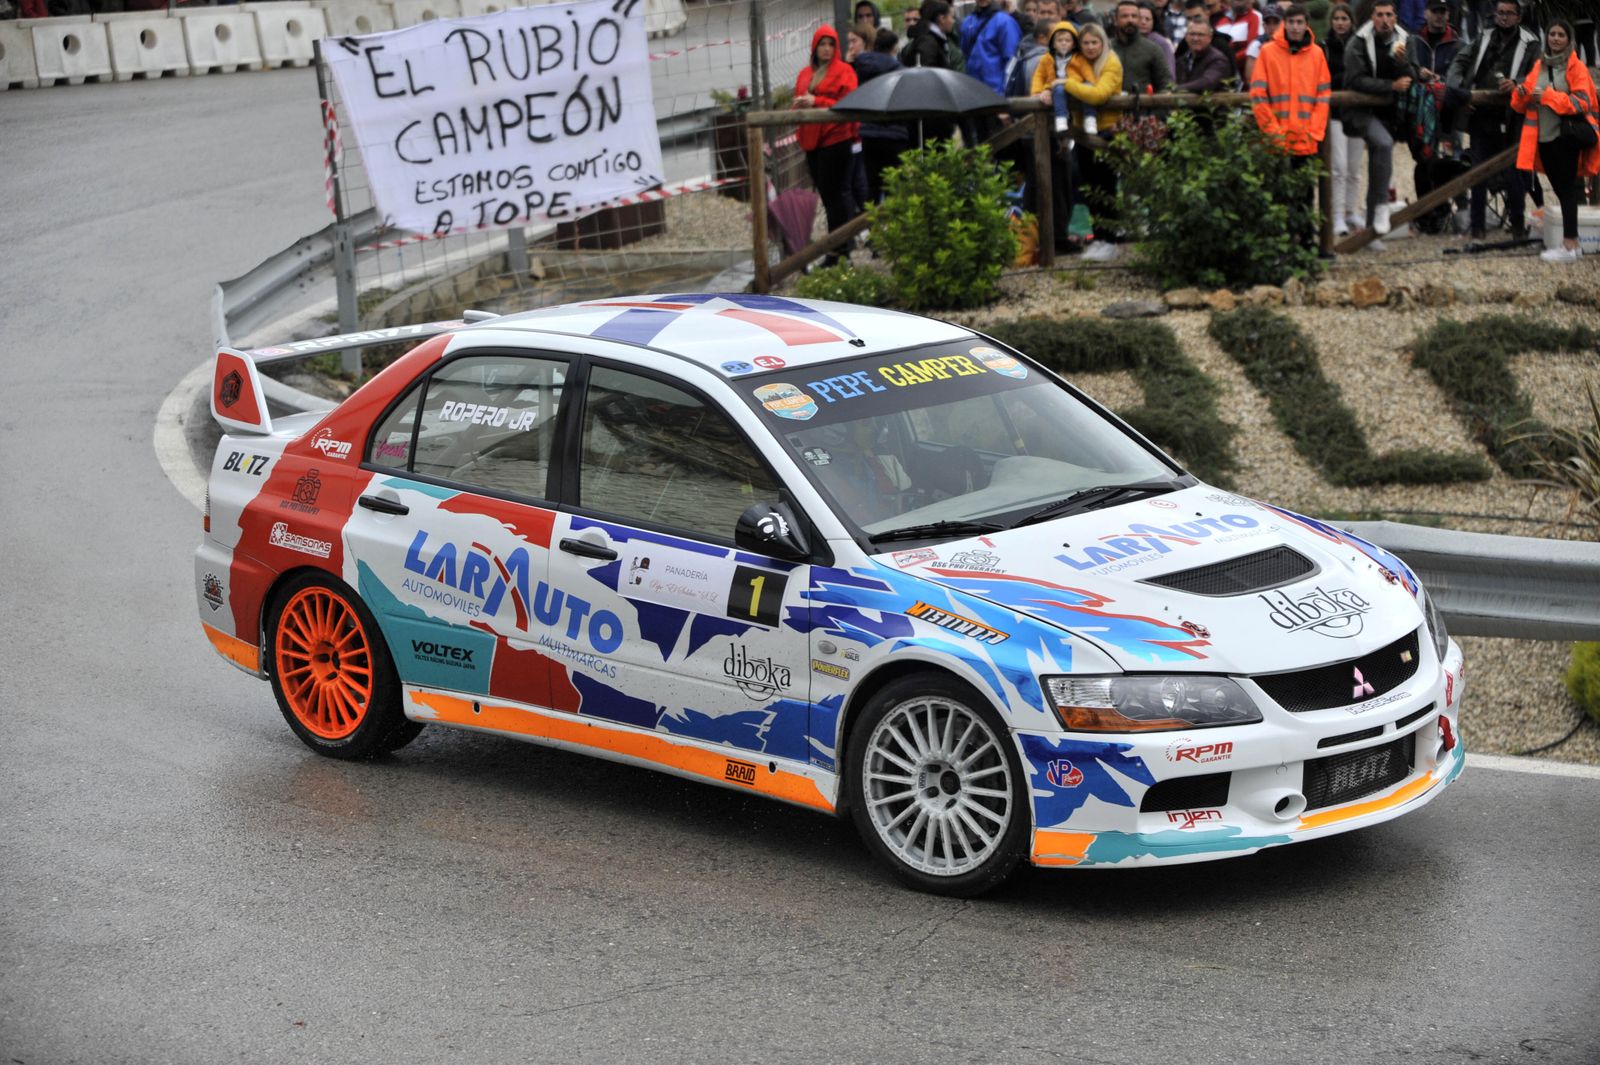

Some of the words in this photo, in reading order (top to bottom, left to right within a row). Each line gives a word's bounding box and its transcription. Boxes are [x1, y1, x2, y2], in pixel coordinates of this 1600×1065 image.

[395, 74, 622, 164] CAMPEÓN
[415, 166, 534, 204] ESTAMOS
[432, 209, 453, 235] A
[806, 370, 888, 403] PEPE
[877, 355, 988, 387] CAMPER
[438, 400, 508, 428] ROPERO
[508, 410, 536, 432] JR
[314, 438, 352, 455] RPM
[284, 532, 332, 553] SAMSONAS
[401, 577, 481, 618] AUTOMOVILES
[749, 575, 766, 617] 1
[411, 639, 474, 662] VOLTEX
[537, 633, 617, 679] MULTIMARCAS
[1175, 742, 1233, 764] RPM
[1200, 754, 1232, 763] GARANTIE
[725, 764, 756, 782] BRAID
[1048, 759, 1073, 788] VP
